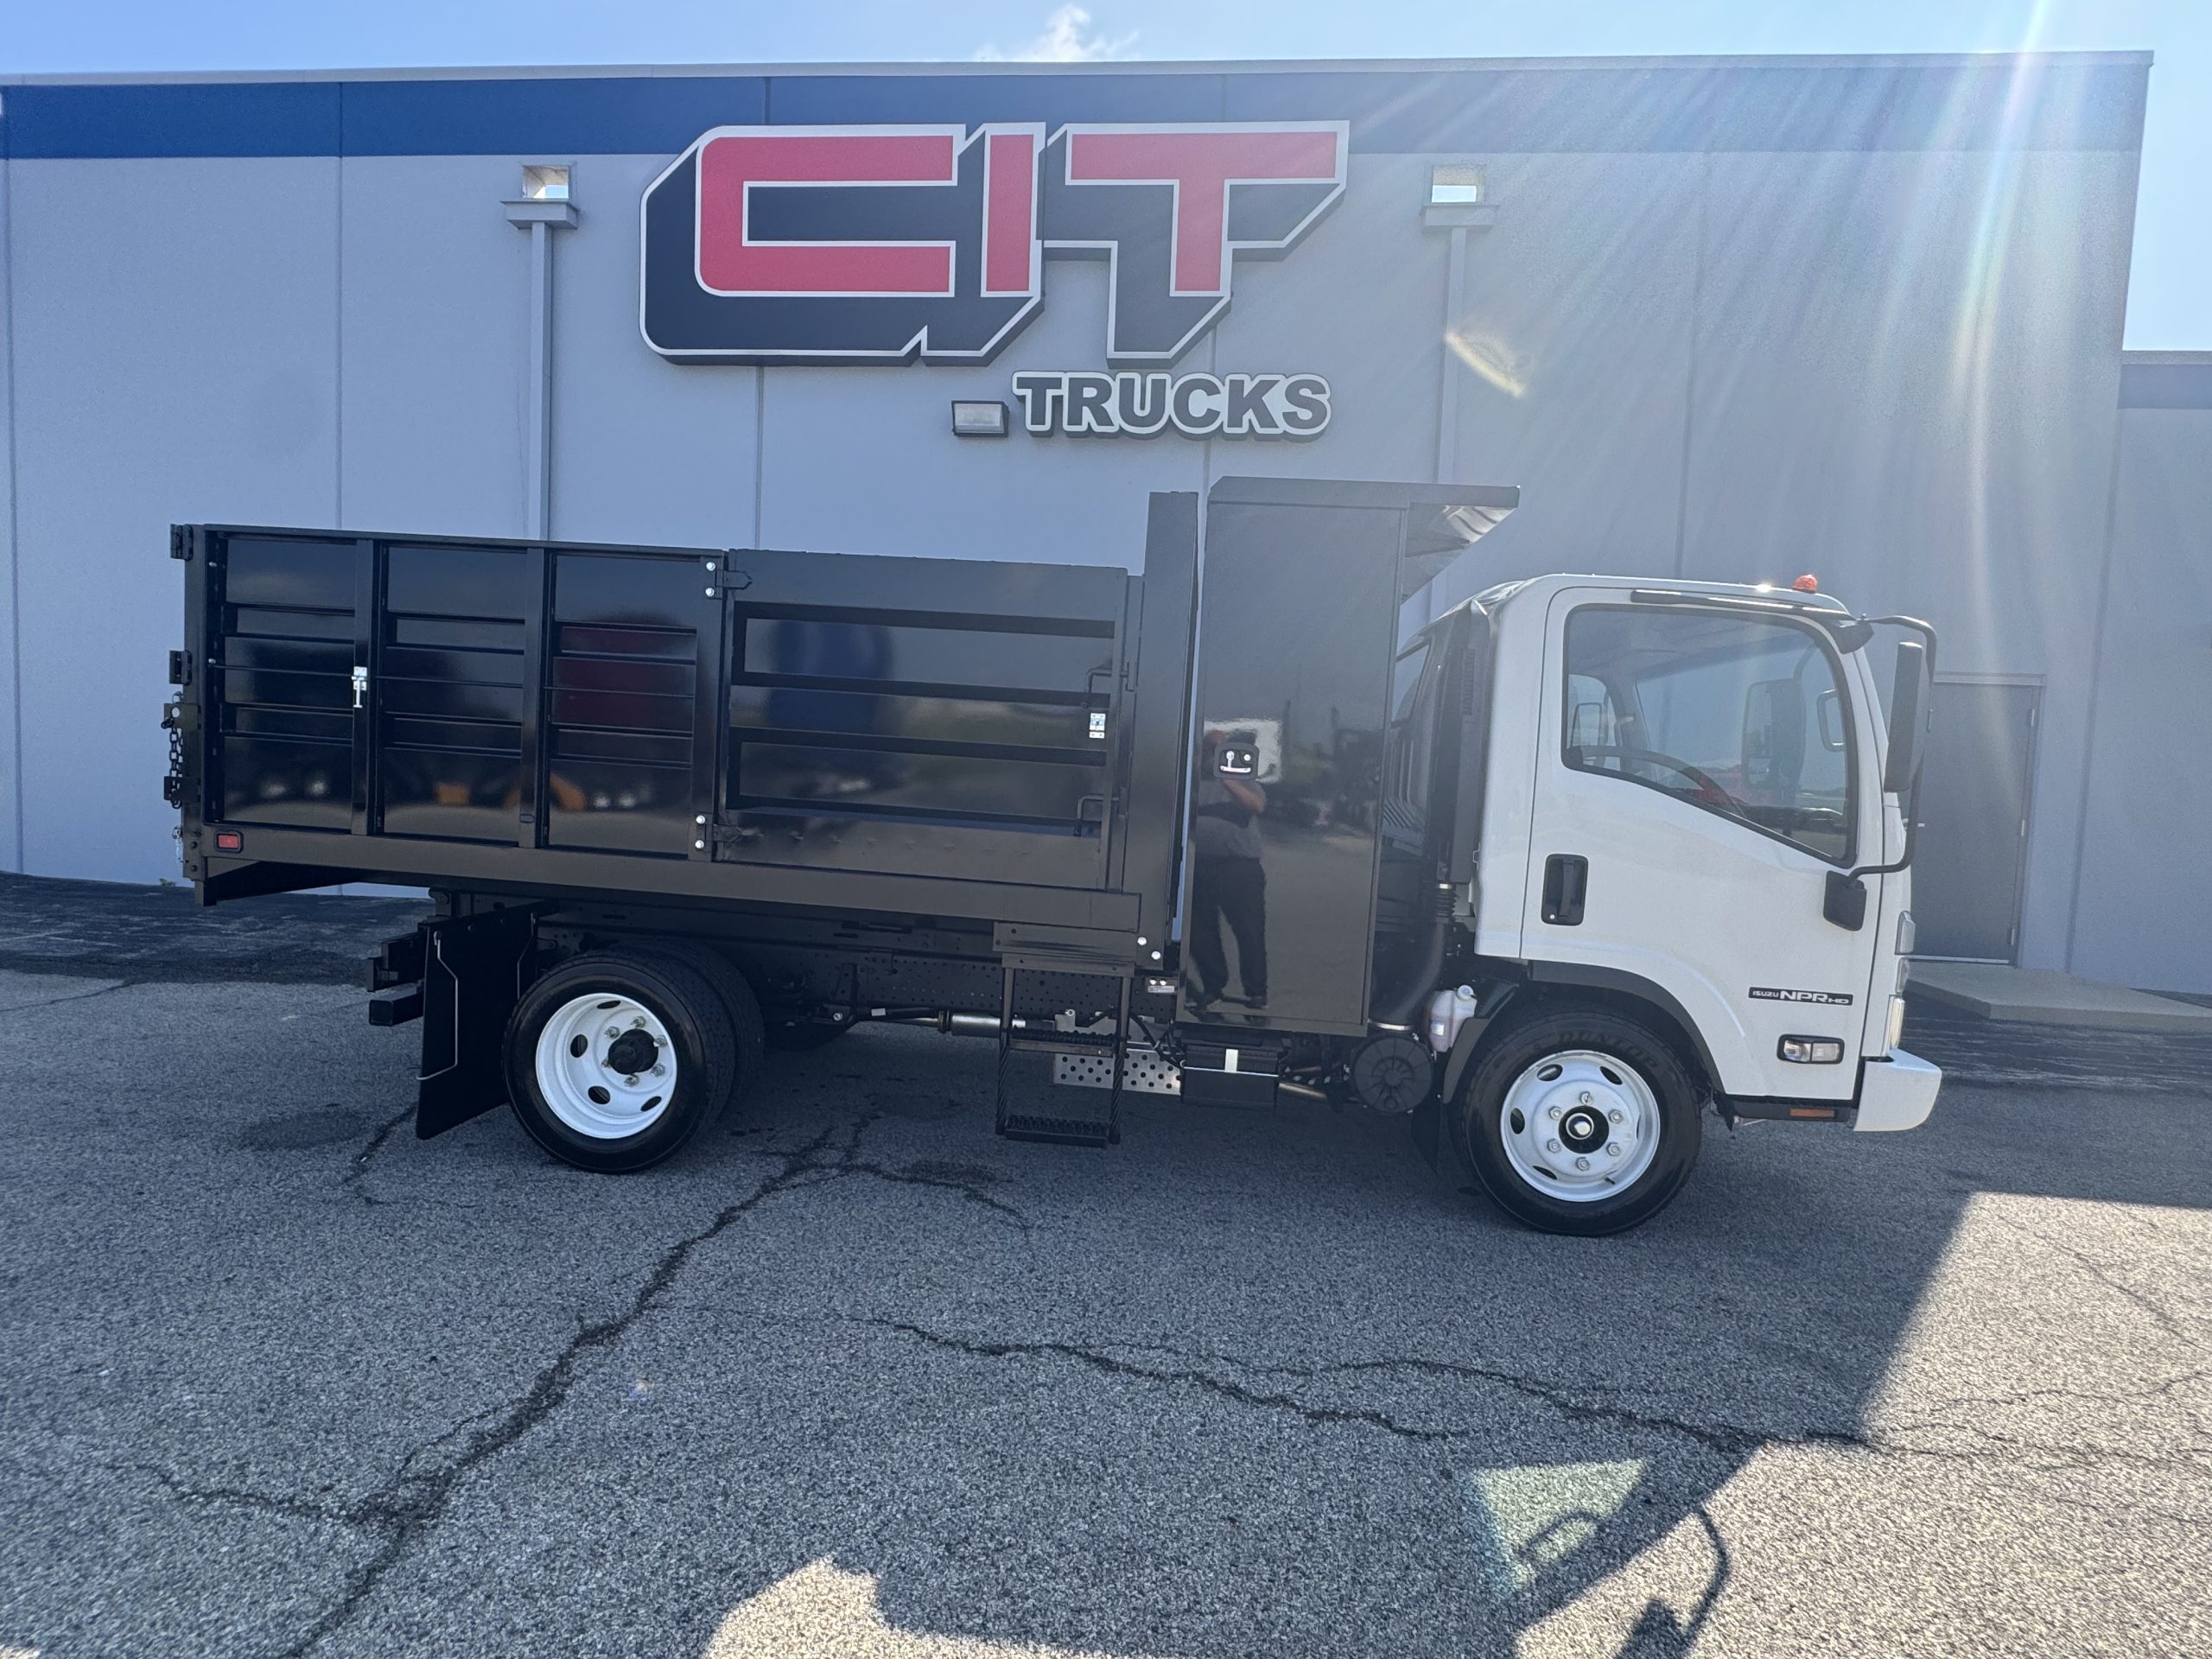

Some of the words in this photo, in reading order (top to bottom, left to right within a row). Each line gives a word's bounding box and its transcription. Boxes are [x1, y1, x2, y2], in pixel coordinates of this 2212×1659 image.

[694, 121, 1350, 298] CIT
[1014, 373, 1331, 435] TRUCKS
[1558, 1030, 1660, 1069] DUNLOP
